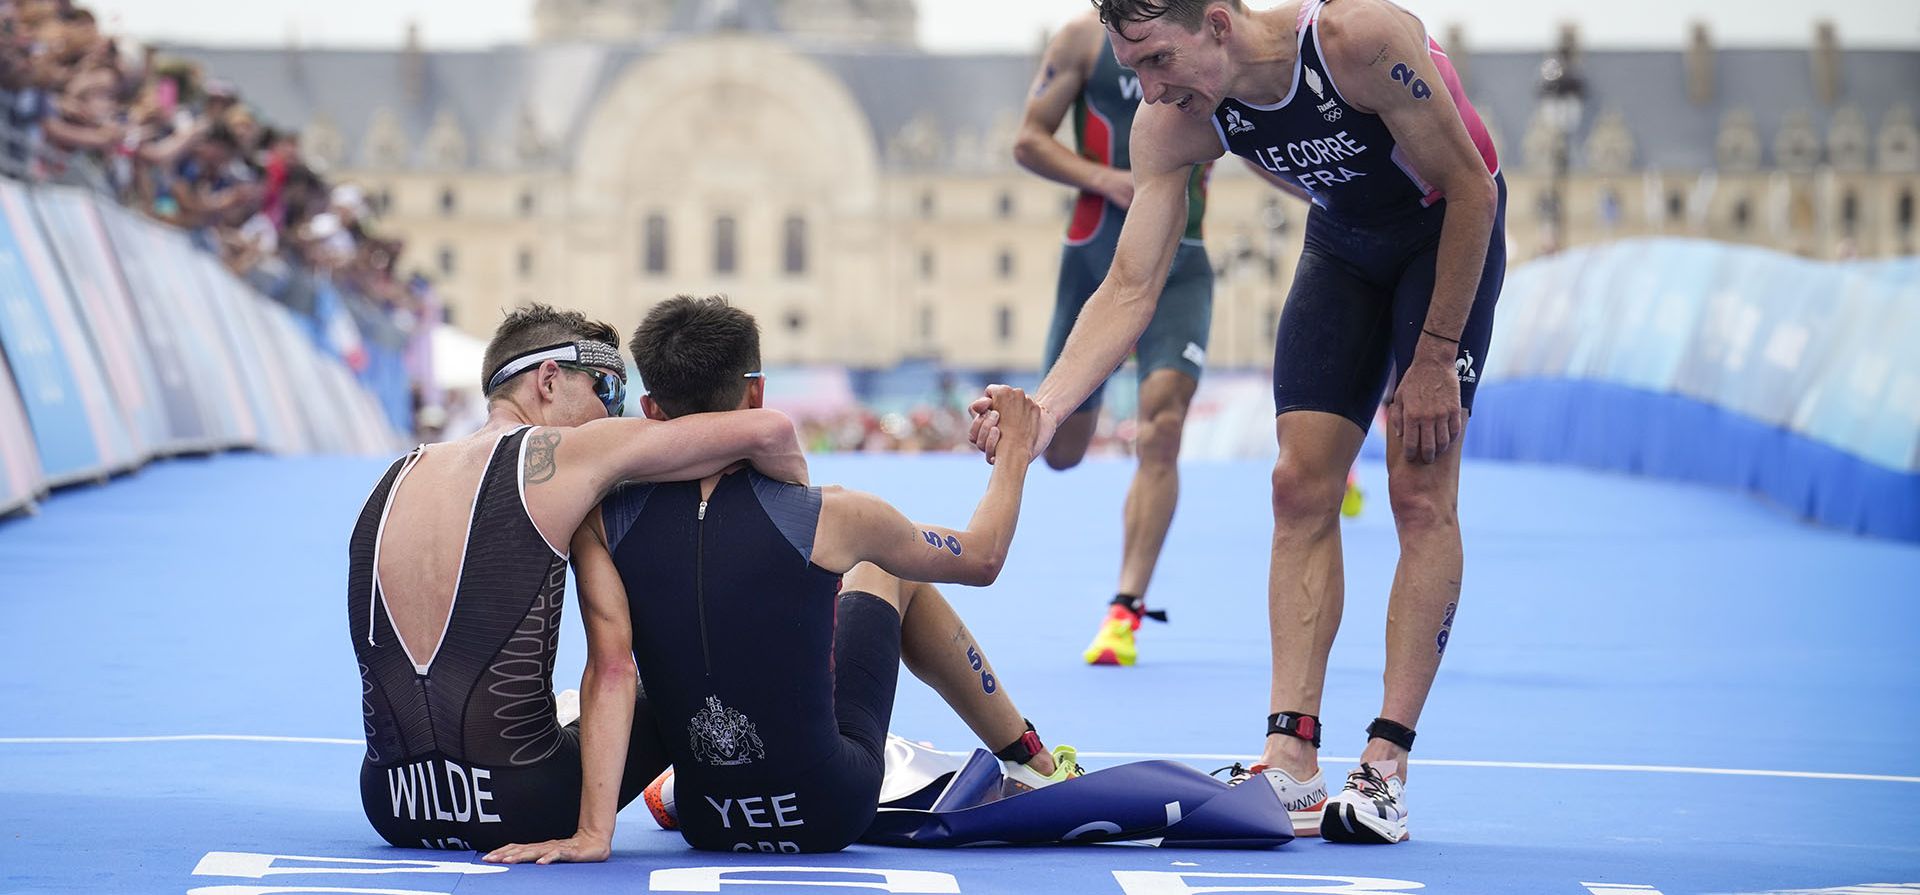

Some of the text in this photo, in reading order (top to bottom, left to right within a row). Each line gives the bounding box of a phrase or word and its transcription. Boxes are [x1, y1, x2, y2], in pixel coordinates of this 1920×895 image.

[1390, 62, 1432, 100] 29
[1255, 130, 1368, 172] LE CORRE
[1297, 166, 1367, 191] FRA
[921, 529, 962, 557] 56
[966, 644, 997, 695] 56
[388, 759, 502, 823] WILDE
[704, 792, 804, 828] YEE
